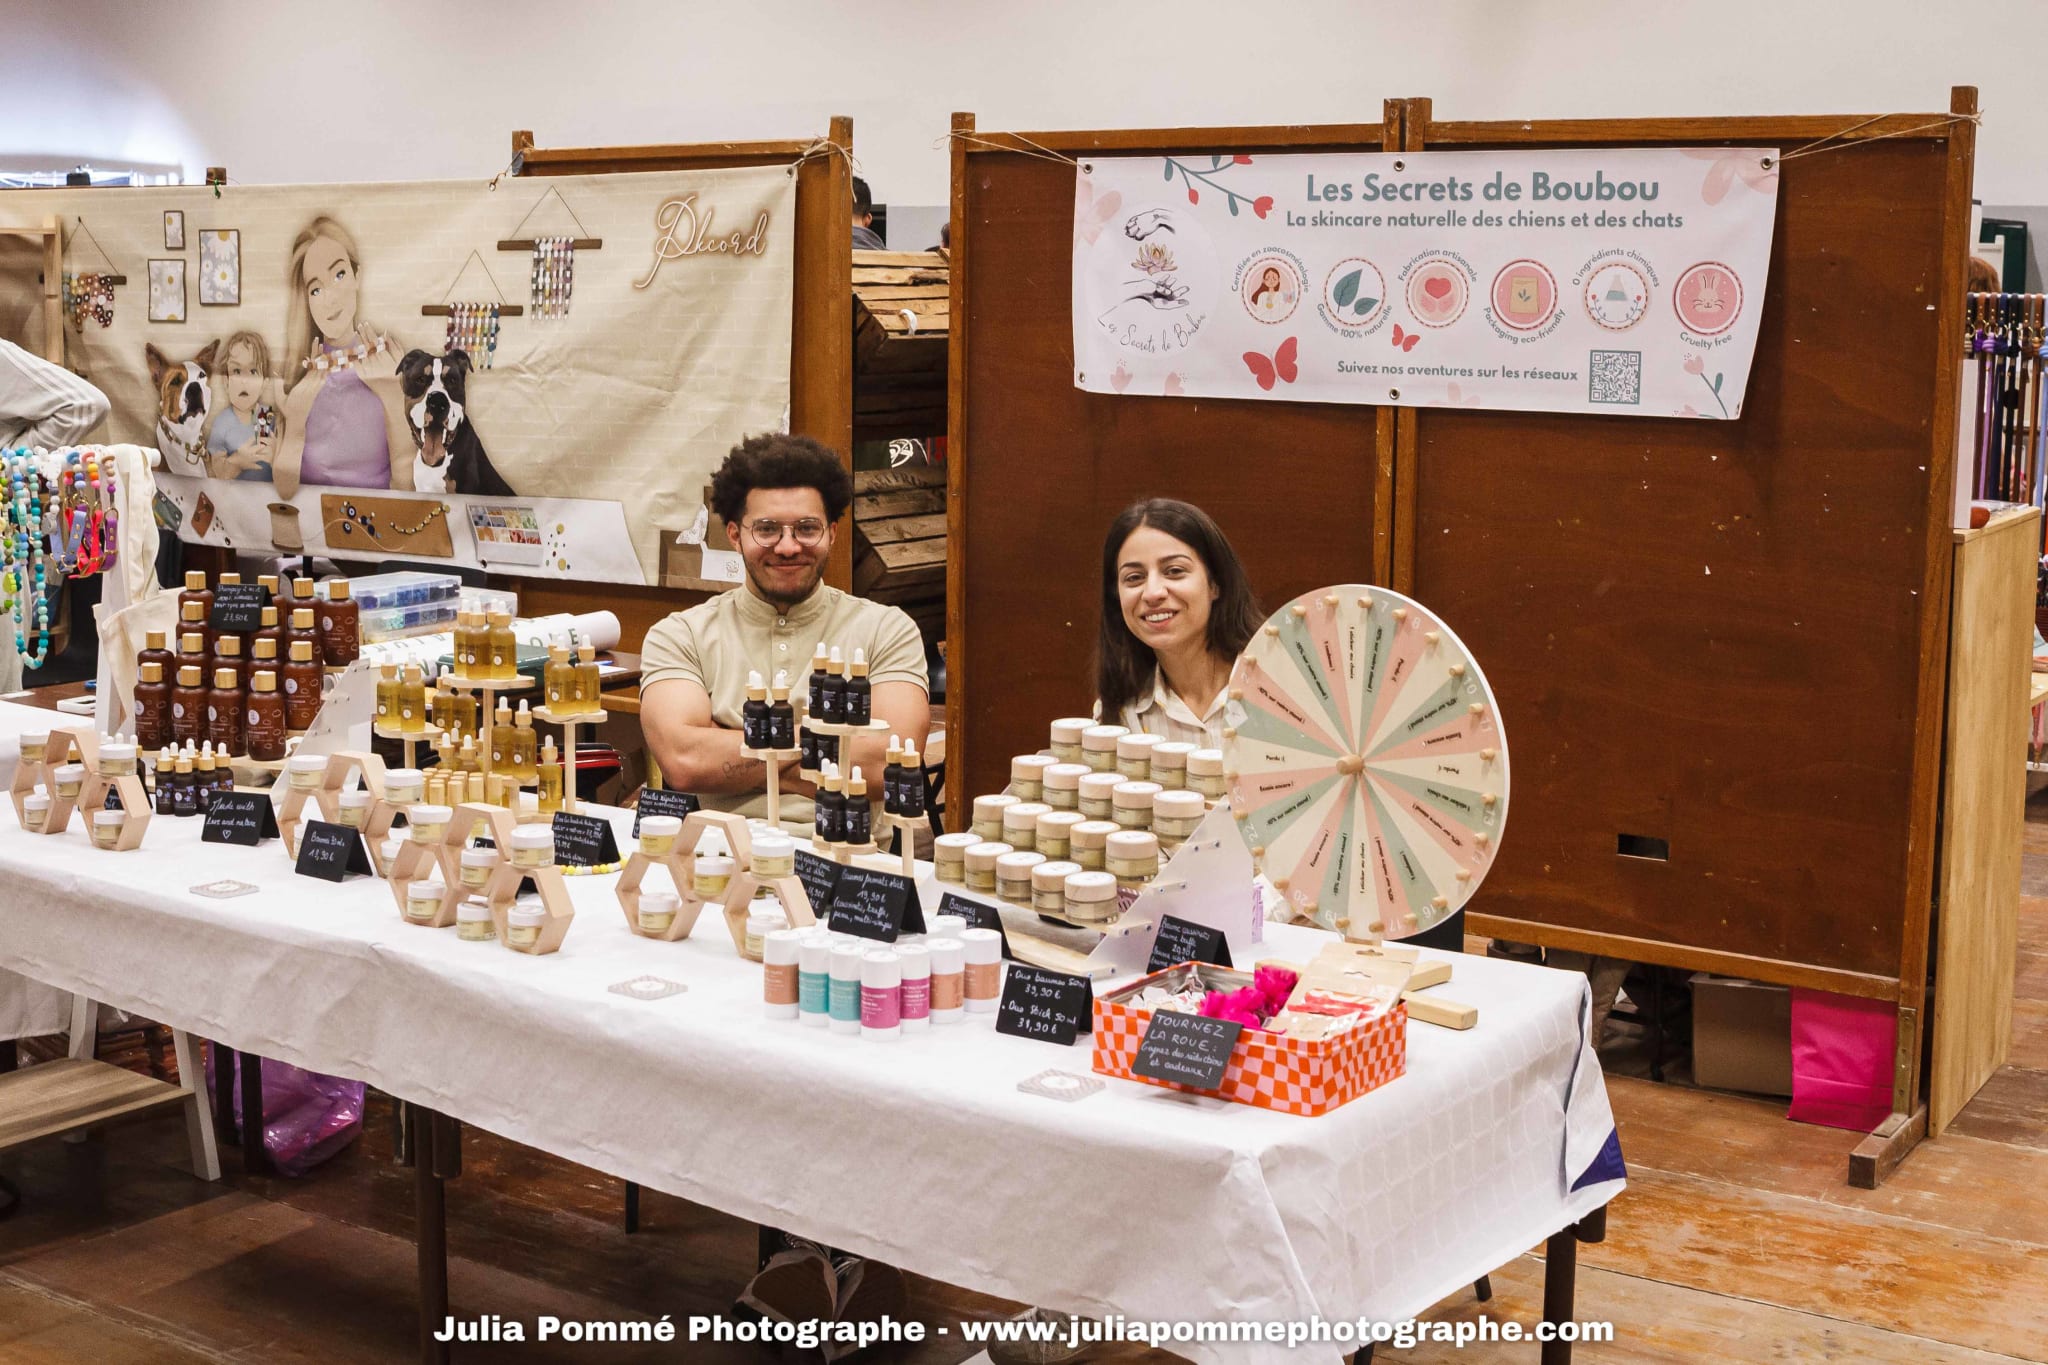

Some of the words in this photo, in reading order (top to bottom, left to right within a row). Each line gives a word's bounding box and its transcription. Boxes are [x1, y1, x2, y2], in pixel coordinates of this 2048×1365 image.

[1307, 174, 1353, 202] Les
[1363, 172, 1473, 202] Secrets
[1482, 171, 1522, 202] de
[1532, 171, 1659, 202] Boubou
[1287, 210, 1306, 227] La
[1311, 210, 1382, 227] skincare
[1387, 210, 1467, 227] naturelle
[1472, 210, 1503, 228] des
[1508, 209, 1566, 228] chiens
[1570, 212, 1589, 228] et
[1594, 209, 1627, 228] des
[1632, 209, 1683, 228] chats
[1232, 253, 1251, 292] Certifiée
[1251, 249, 1261, 258] en
[1398, 249, 1440, 281] Fabrication
[1442, 250, 1477, 282] artisanale
[1577, 248, 1624, 279] ingrédients
[1627, 250, 1660, 288] chimiques
[1317, 303, 1338, 333] Gamme
[1341, 329, 1362, 338] 100%
[1364, 305, 1392, 336] naturelle
[1484, 307, 1518, 344] Packaging
[1521, 308, 1566, 344] eco-friendly
[1120, 324, 1155, 353] Secrets
[1680, 331, 1712, 349] Cruelty
[1714, 333, 1732, 346] free
[1337, 360, 1378, 374] Suivez
[1382, 364, 1404, 375] nos
[1407, 366, 1473, 377] aventures
[1477, 368, 1498, 378] sur
[1502, 365, 1520, 379] les
[1523, 367, 1578, 380] réseaux
[236, 801, 255, 811] with
[949, 897, 976, 916] Baumes
[1015, 970, 1030, 980] Duo
[1035, 972, 1065, 986] baumes
[1008, 1000, 1024, 1013] Duo
[1156, 1014, 1225, 1038] TOURNEZ
[1150, 1029, 1166, 1040] LA
[1171, 1034, 1209, 1052] ROUE
[1150, 1058, 1160, 1067] et
